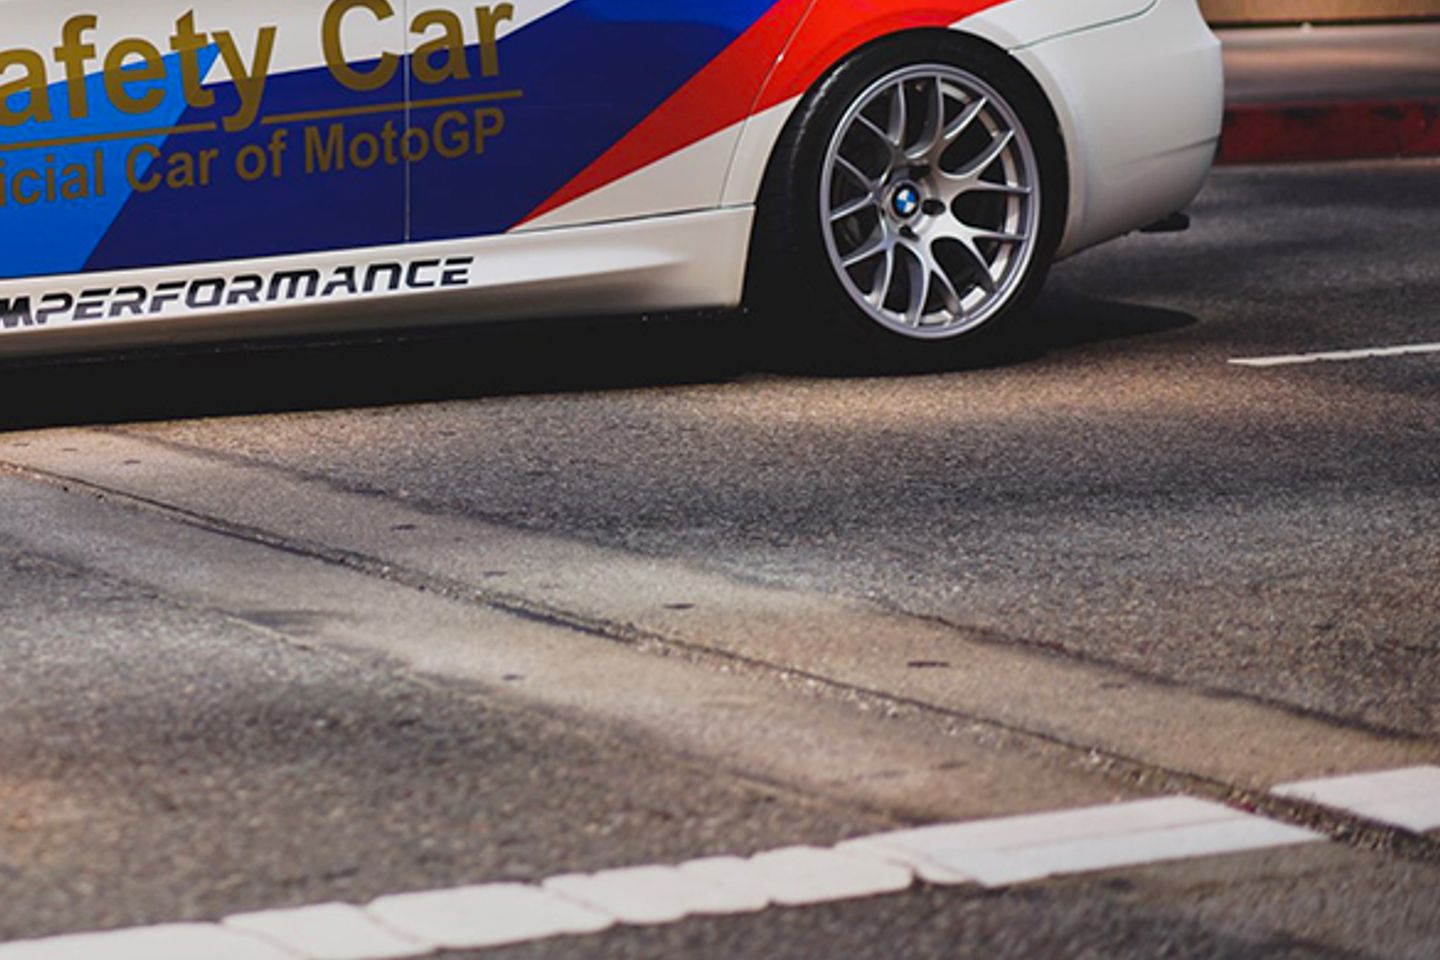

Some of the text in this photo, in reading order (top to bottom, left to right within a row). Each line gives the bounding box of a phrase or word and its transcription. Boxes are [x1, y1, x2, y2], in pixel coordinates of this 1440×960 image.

[125, 143, 210, 192] Car
[235, 139, 287, 181] of
[304, 107, 506, 173] MotoGP
